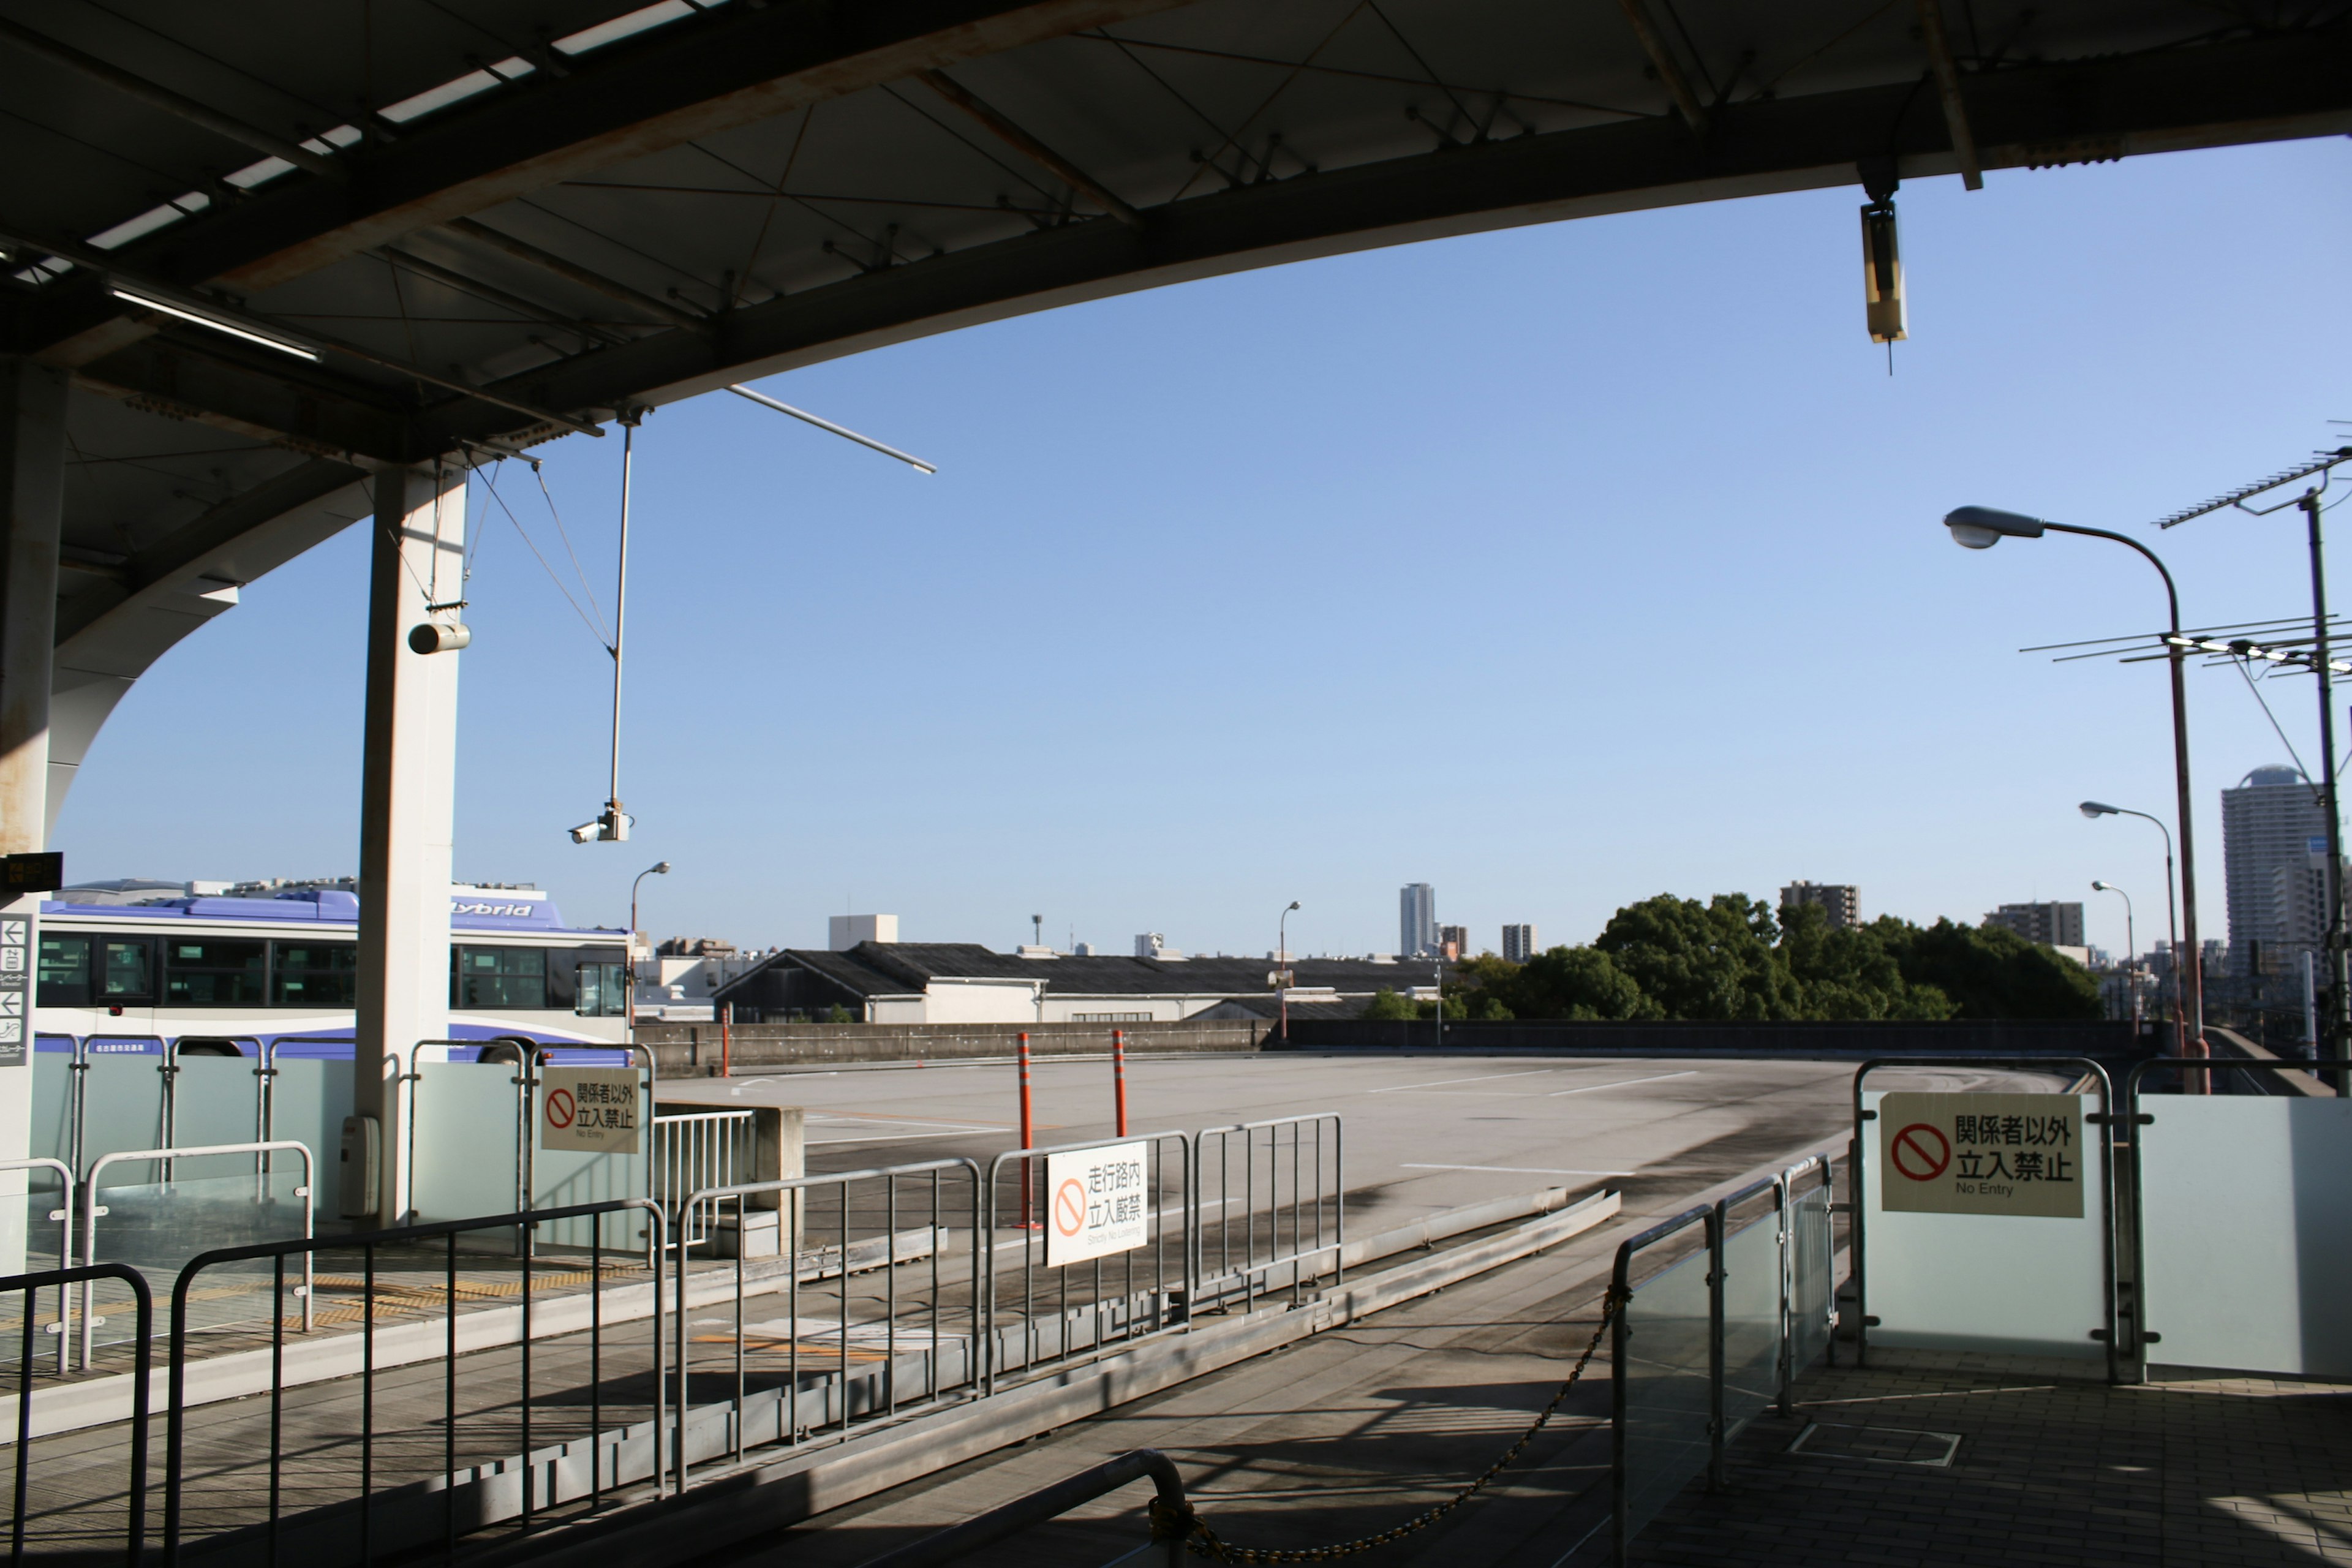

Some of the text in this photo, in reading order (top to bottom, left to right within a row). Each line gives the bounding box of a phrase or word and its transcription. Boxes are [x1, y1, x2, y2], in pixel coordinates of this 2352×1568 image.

[577, 1083, 633, 1104] 関係者以外
[577, 1107, 633, 1129] 立入禁止
[587, 1130, 605, 1140] Entry
[1956, 1115, 2071, 1146] 関係者以外
[1088, 1159, 1140, 1194] 走行路内
[1956, 1150, 2073, 1182] 立入禁止
[1956, 1183, 2013, 1197] No Entry
[1088, 1193, 1141, 1229] 立入厳禁
[1088, 1226, 1140, 1245] Strictly No Loitering
